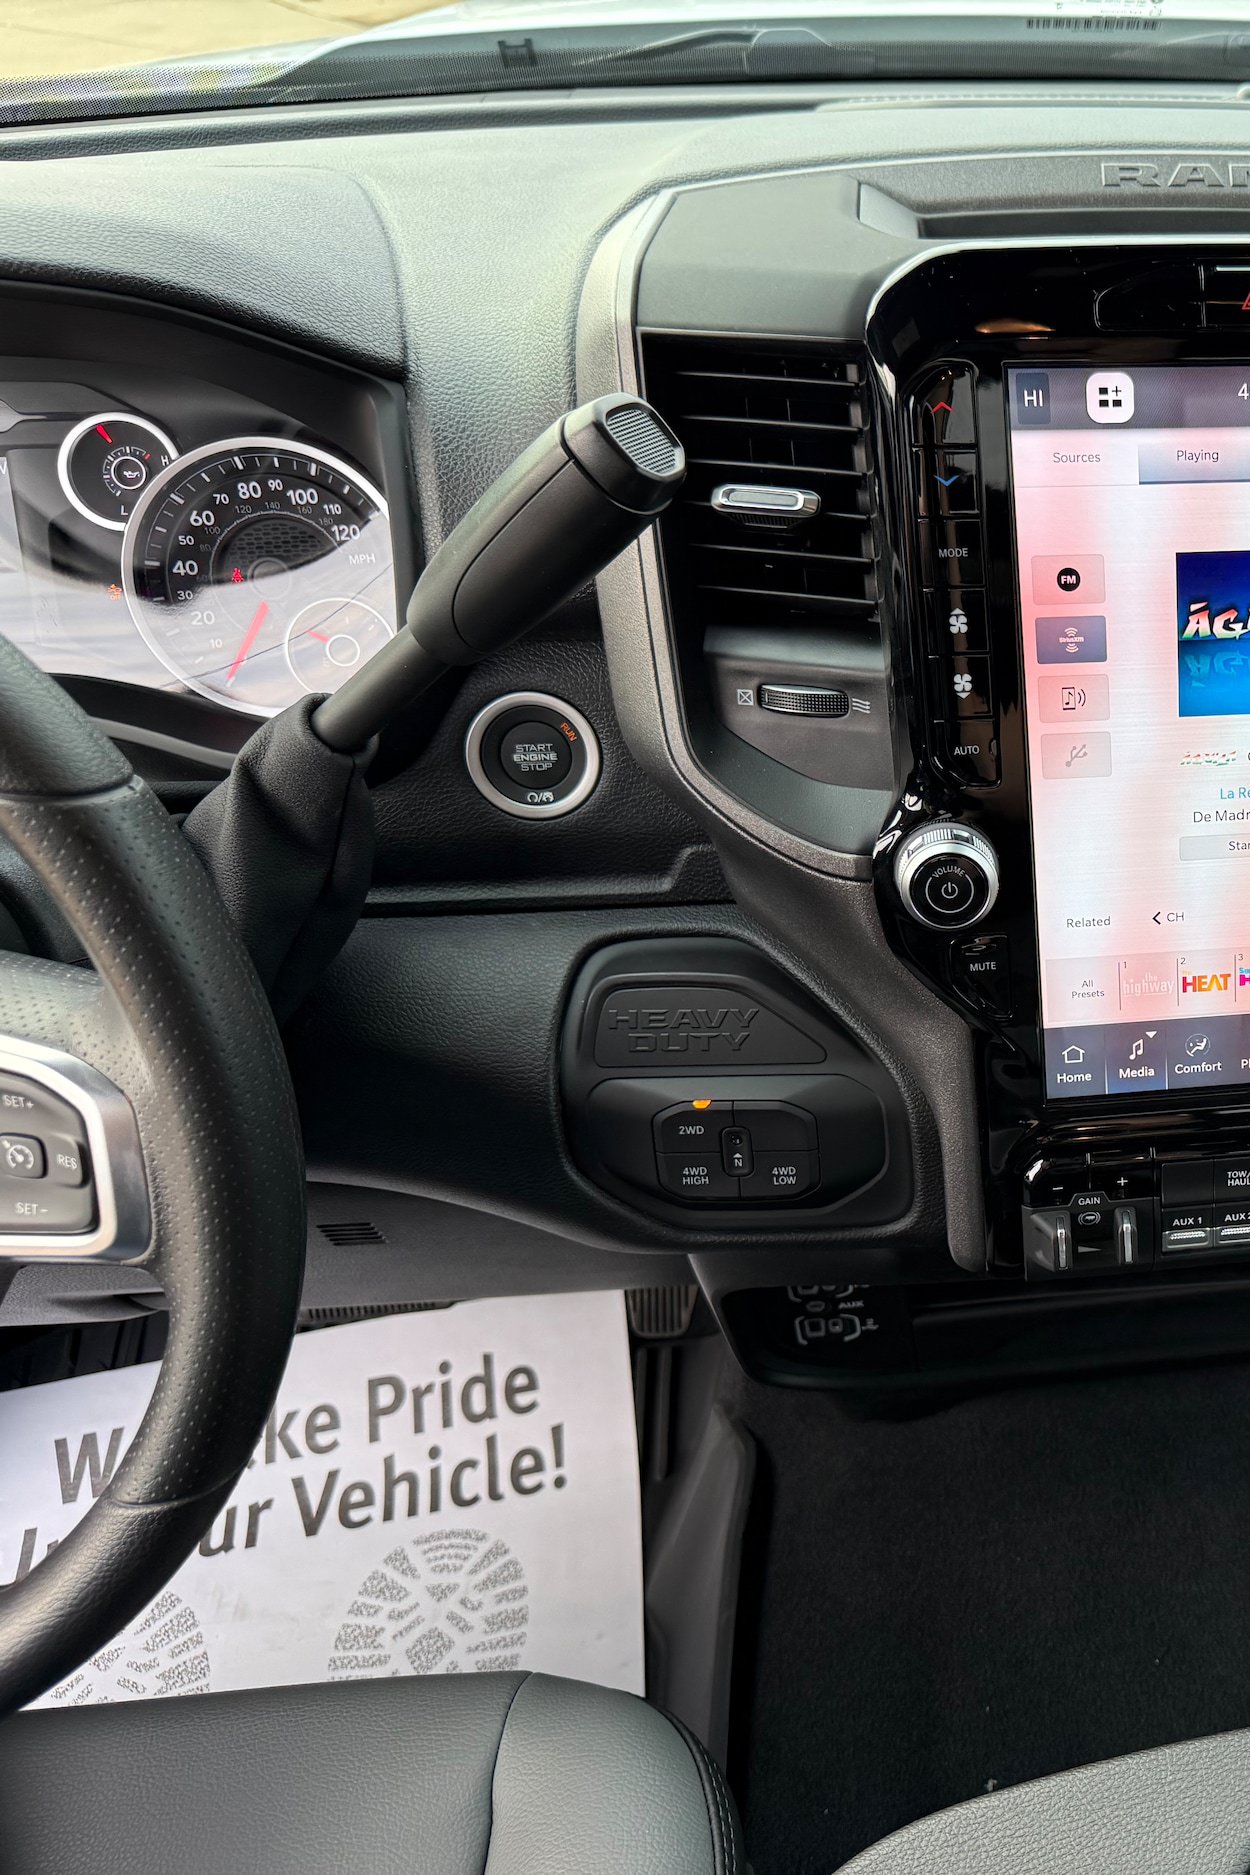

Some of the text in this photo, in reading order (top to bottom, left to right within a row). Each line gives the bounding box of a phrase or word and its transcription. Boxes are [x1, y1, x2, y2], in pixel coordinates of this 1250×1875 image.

[1023, 389, 1043, 408] HI
[161, 455, 170, 466] H
[1052, 451, 1101, 464] Sources
[1176, 448, 1219, 464] Playing
[237, 481, 262, 500] 80
[268, 479, 283, 491] 90
[213, 493, 230, 505] 70
[286, 488, 319, 506] 100
[120, 505, 129, 516] L
[235, 505, 252, 515] 120
[264, 501, 281, 511] 140
[323, 504, 342, 515] 110
[189, 510, 215, 527] 60
[331, 524, 361, 542] 120
[178, 535, 195, 546] 50
[938, 548, 969, 559] MODE
[348, 554, 376, 565] MPH
[172, 560, 199, 577] 40
[1060, 575, 1077, 585] FM
[177, 590, 194, 601] 30
[191, 611, 215, 626] 20
[209, 638, 223, 649] 10
[560, 722, 578, 742] RUN
[515, 743, 553, 753] START
[954, 745, 980, 756] AUTO
[513, 753, 558, 762] ENGINE
[521, 762, 553, 772] STOP
[1220, 787, 1235, 800] La
[1193, 811, 1212, 823] De
[931, 865, 966, 879] VOLUME
[1066, 916, 1112, 928] Related
[1166, 911, 1185, 923] CH
[1180, 957, 1186, 965] 2
[1238, 953, 1244, 961] 3
[970, 961, 997, 972] MUTE
[1082, 978, 1094, 988] All
[1123, 979, 1175, 997] highway
[1182, 973, 1232, 993] HEAT
[1071, 988, 1105, 999] Presets
[608, 1008, 760, 1030] HEAVY
[627, 1032, 751, 1053] DUTY
[1118, 1065, 1155, 1079] Media
[1174, 1060, 1222, 1075] Comfort
[1057, 1070, 1092, 1084] Home
[679, 1125, 705, 1135] 2WD
[57, 1154, 78, 1171] RES
[734, 1159, 743, 1167] N
[682, 1167, 708, 1176] 4WD
[772, 1166, 796, 1175] 4WD
[682, 1176, 709, 1185] HIGH
[773, 1176, 797, 1185] LOW
[1078, 1197, 1101, 1206] GAIN
[1172, 1216, 1203, 1226] AUX 1
[1224, 1213, 1246, 1222] AUX
[367, 1351, 540, 1445] Pride
[199, 1498, 275, 1557] ur
[292, 1424, 570, 1538] Vehicle!
